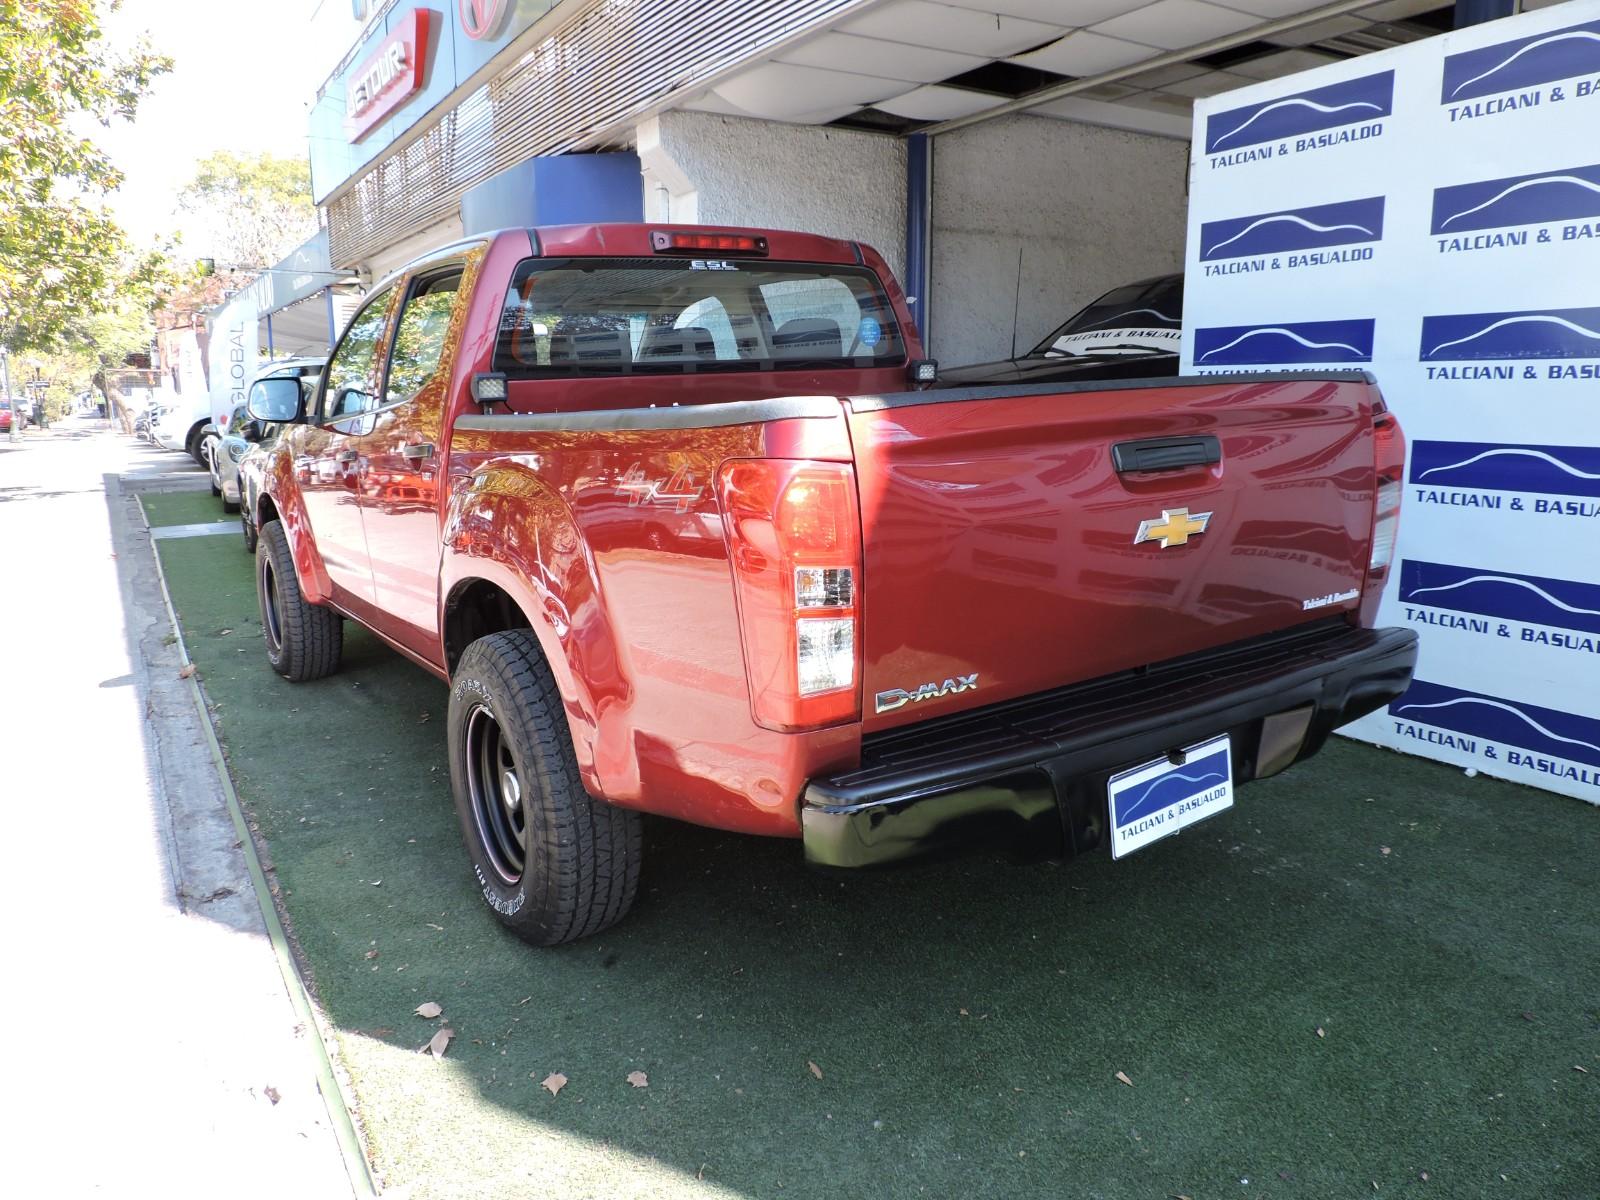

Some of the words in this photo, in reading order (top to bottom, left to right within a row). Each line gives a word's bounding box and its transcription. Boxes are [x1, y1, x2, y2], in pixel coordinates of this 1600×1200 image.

[1448, 91, 1541, 122] TALCIANI
[1550, 87, 1565, 102] &
[1210, 147, 1272, 169] TALCIANI
[1278, 143, 1288, 156] &
[1296, 123, 1383, 152] BASUALDO
[1438, 231, 1528, 253] TALCIANI
[1536, 229, 1552, 243] &
[1204, 260, 1265, 277] TALCIANI
[1271, 258, 1281, 270] &
[1288, 247, 1374, 268] BASUALDO
[1426, 366, 1514, 380] TALCIANI
[1523, 366, 1537, 380] &
[1416, 490, 1501, 509] TALCIANI
[1510, 497, 1524, 511] &
[1405, 607, 1488, 634] TALCIANI
[1497, 624, 1511, 638] &
[876, 673, 979, 714] D-MAX
[1394, 721, 1476, 754] TALCIANI
[1484, 746, 1498, 759] &
[1120, 814, 1165, 841] TALCIANI
[1168, 810, 1175, 820] &
[1178, 786, 1227, 815] BASUALDO
